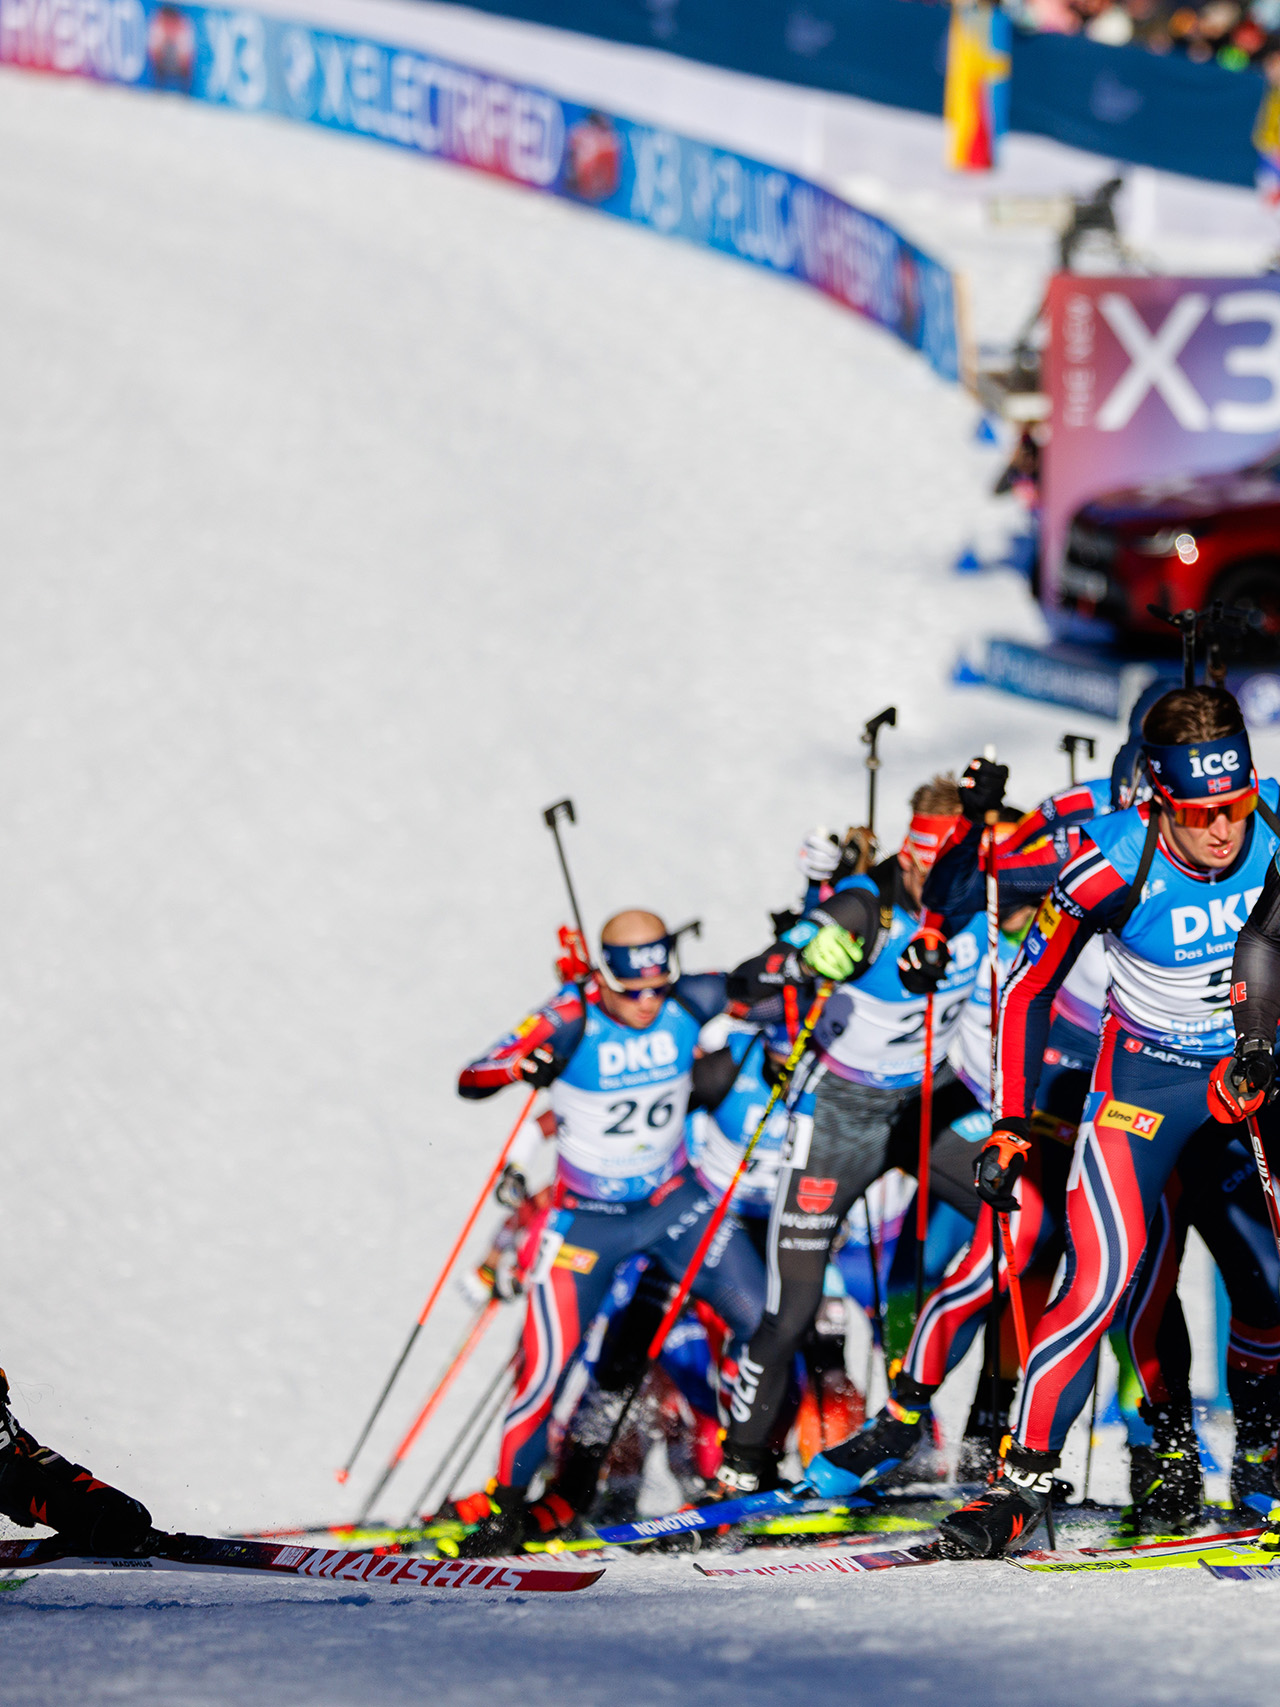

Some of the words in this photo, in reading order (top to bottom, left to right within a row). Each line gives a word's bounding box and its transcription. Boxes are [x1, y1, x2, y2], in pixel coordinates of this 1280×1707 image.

[1189, 748, 1241, 779] ice
[1175, 948, 1203, 962] Das
[597, 1030, 679, 1077] DKB
[603, 1089, 675, 1135] 26
[1107, 1109, 1132, 1122] Uno
[631, 1509, 706, 1538] SALOMON
[111, 1560, 154, 1569] MADSHUS
[298, 1548, 538, 1591] MADSHUS
[1049, 1560, 1132, 1573] FISCHER
